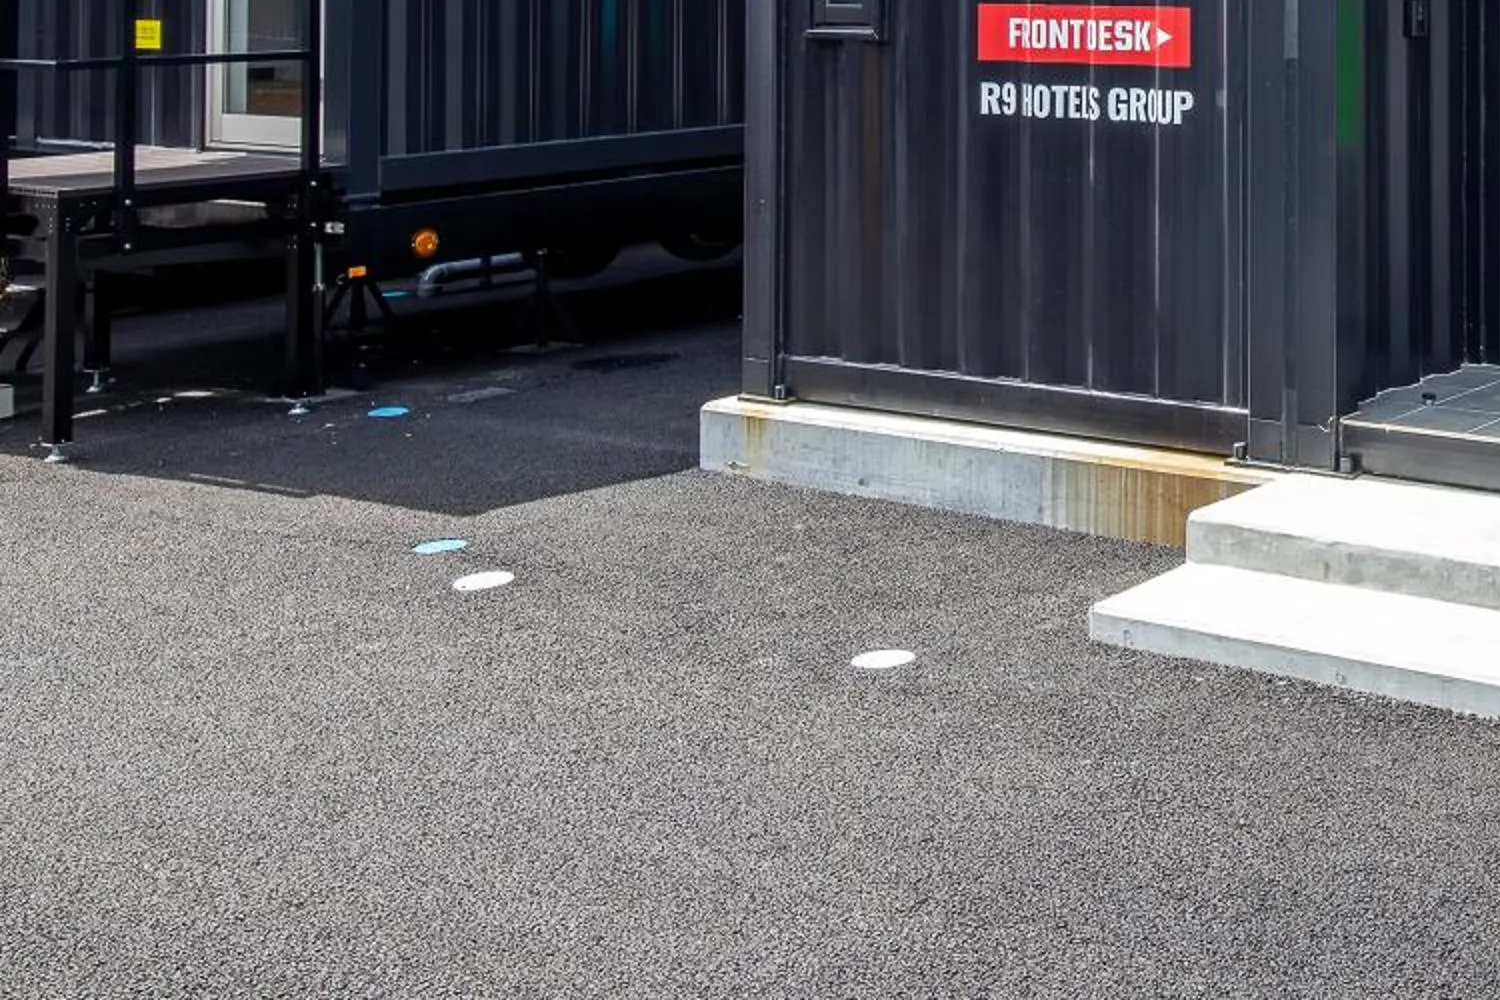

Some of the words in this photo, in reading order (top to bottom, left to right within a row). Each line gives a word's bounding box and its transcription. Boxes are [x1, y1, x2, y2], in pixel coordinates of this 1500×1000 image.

[980, 81, 1017, 115] R9
[1021, 83, 1101, 121] HOTELS
[1107, 87, 1195, 125] GROUP
